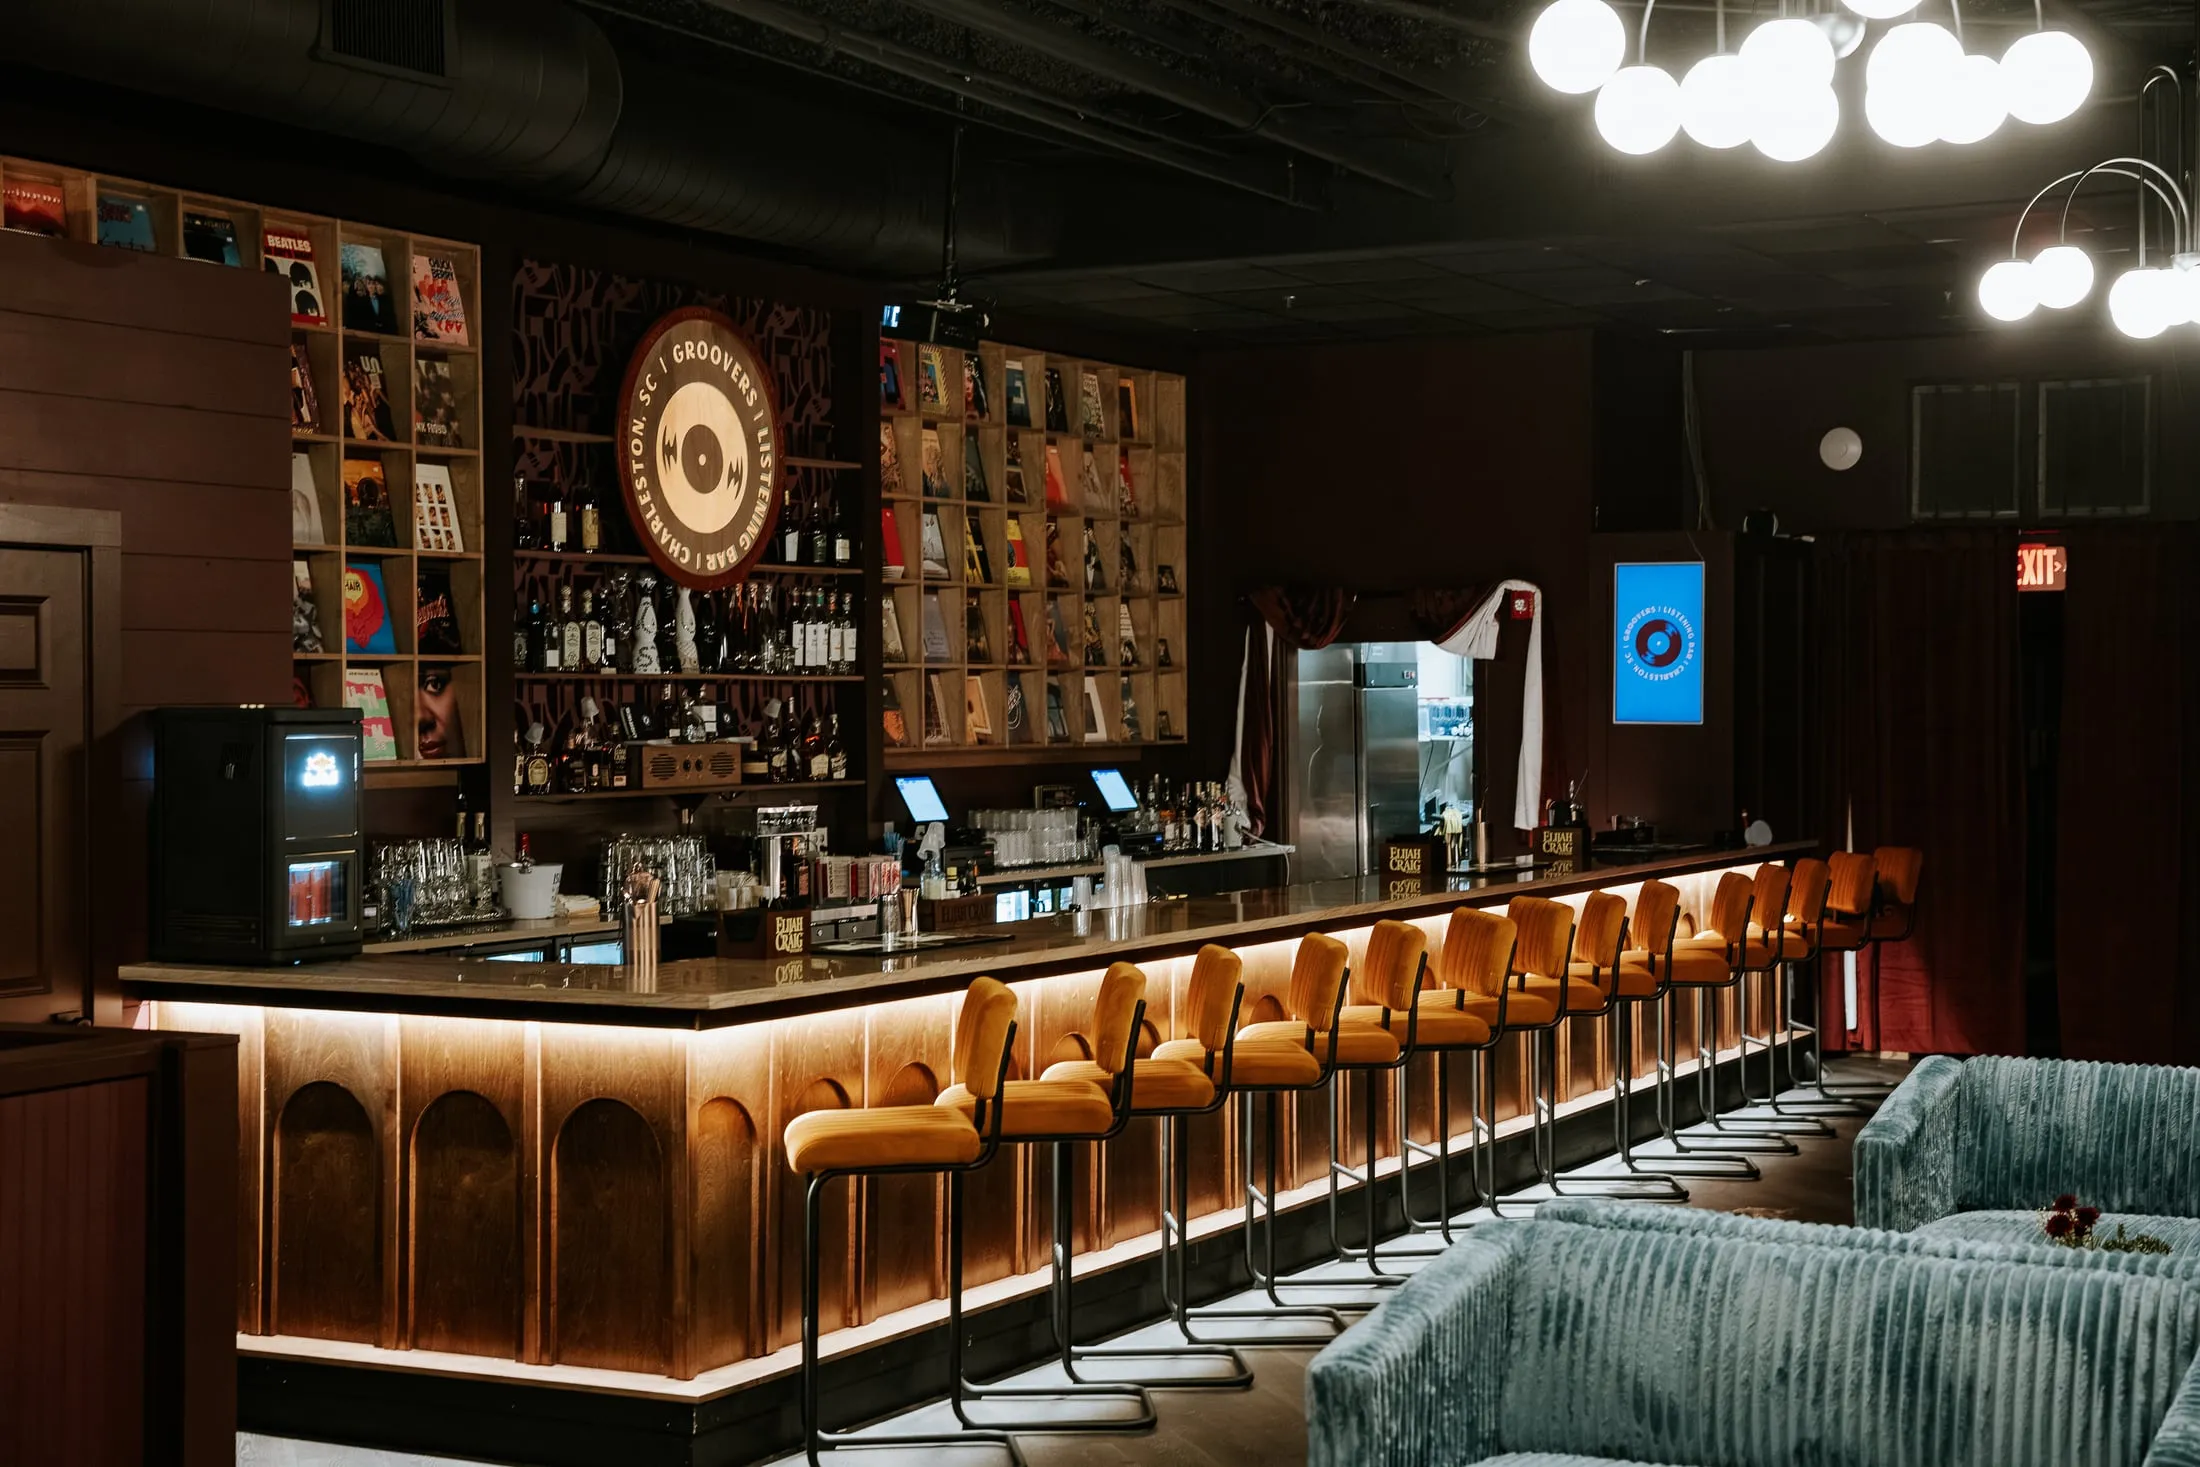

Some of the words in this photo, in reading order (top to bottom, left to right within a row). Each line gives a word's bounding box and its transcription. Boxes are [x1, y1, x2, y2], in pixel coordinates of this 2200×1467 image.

[267, 234, 312, 252] BEATLES
[672, 340, 758, 408] GROOVERS
[639, 373, 658, 408] SC
[631, 416, 691, 565] CHARLESTON,
[738, 425, 774, 552] LISTENING
[706, 542, 738, 572] BAR
[345, 579, 361, 591] HAIR
[1624, 605, 1656, 641] GROOVERS
[1663, 606, 1695, 639] LISTENING
[1686, 641, 1695, 661] BAR
[1624, 652, 1635, 665] SC
[1542, 831, 1573, 844] ELIJAH
[1389, 846, 1421, 860] ELIJAH
[1542, 841, 1573, 854] CRAIG
[1389, 858, 1421, 873] CRAIG
[775, 916, 804, 934] ELIJAH
[775, 931, 804, 952] CRAIG
